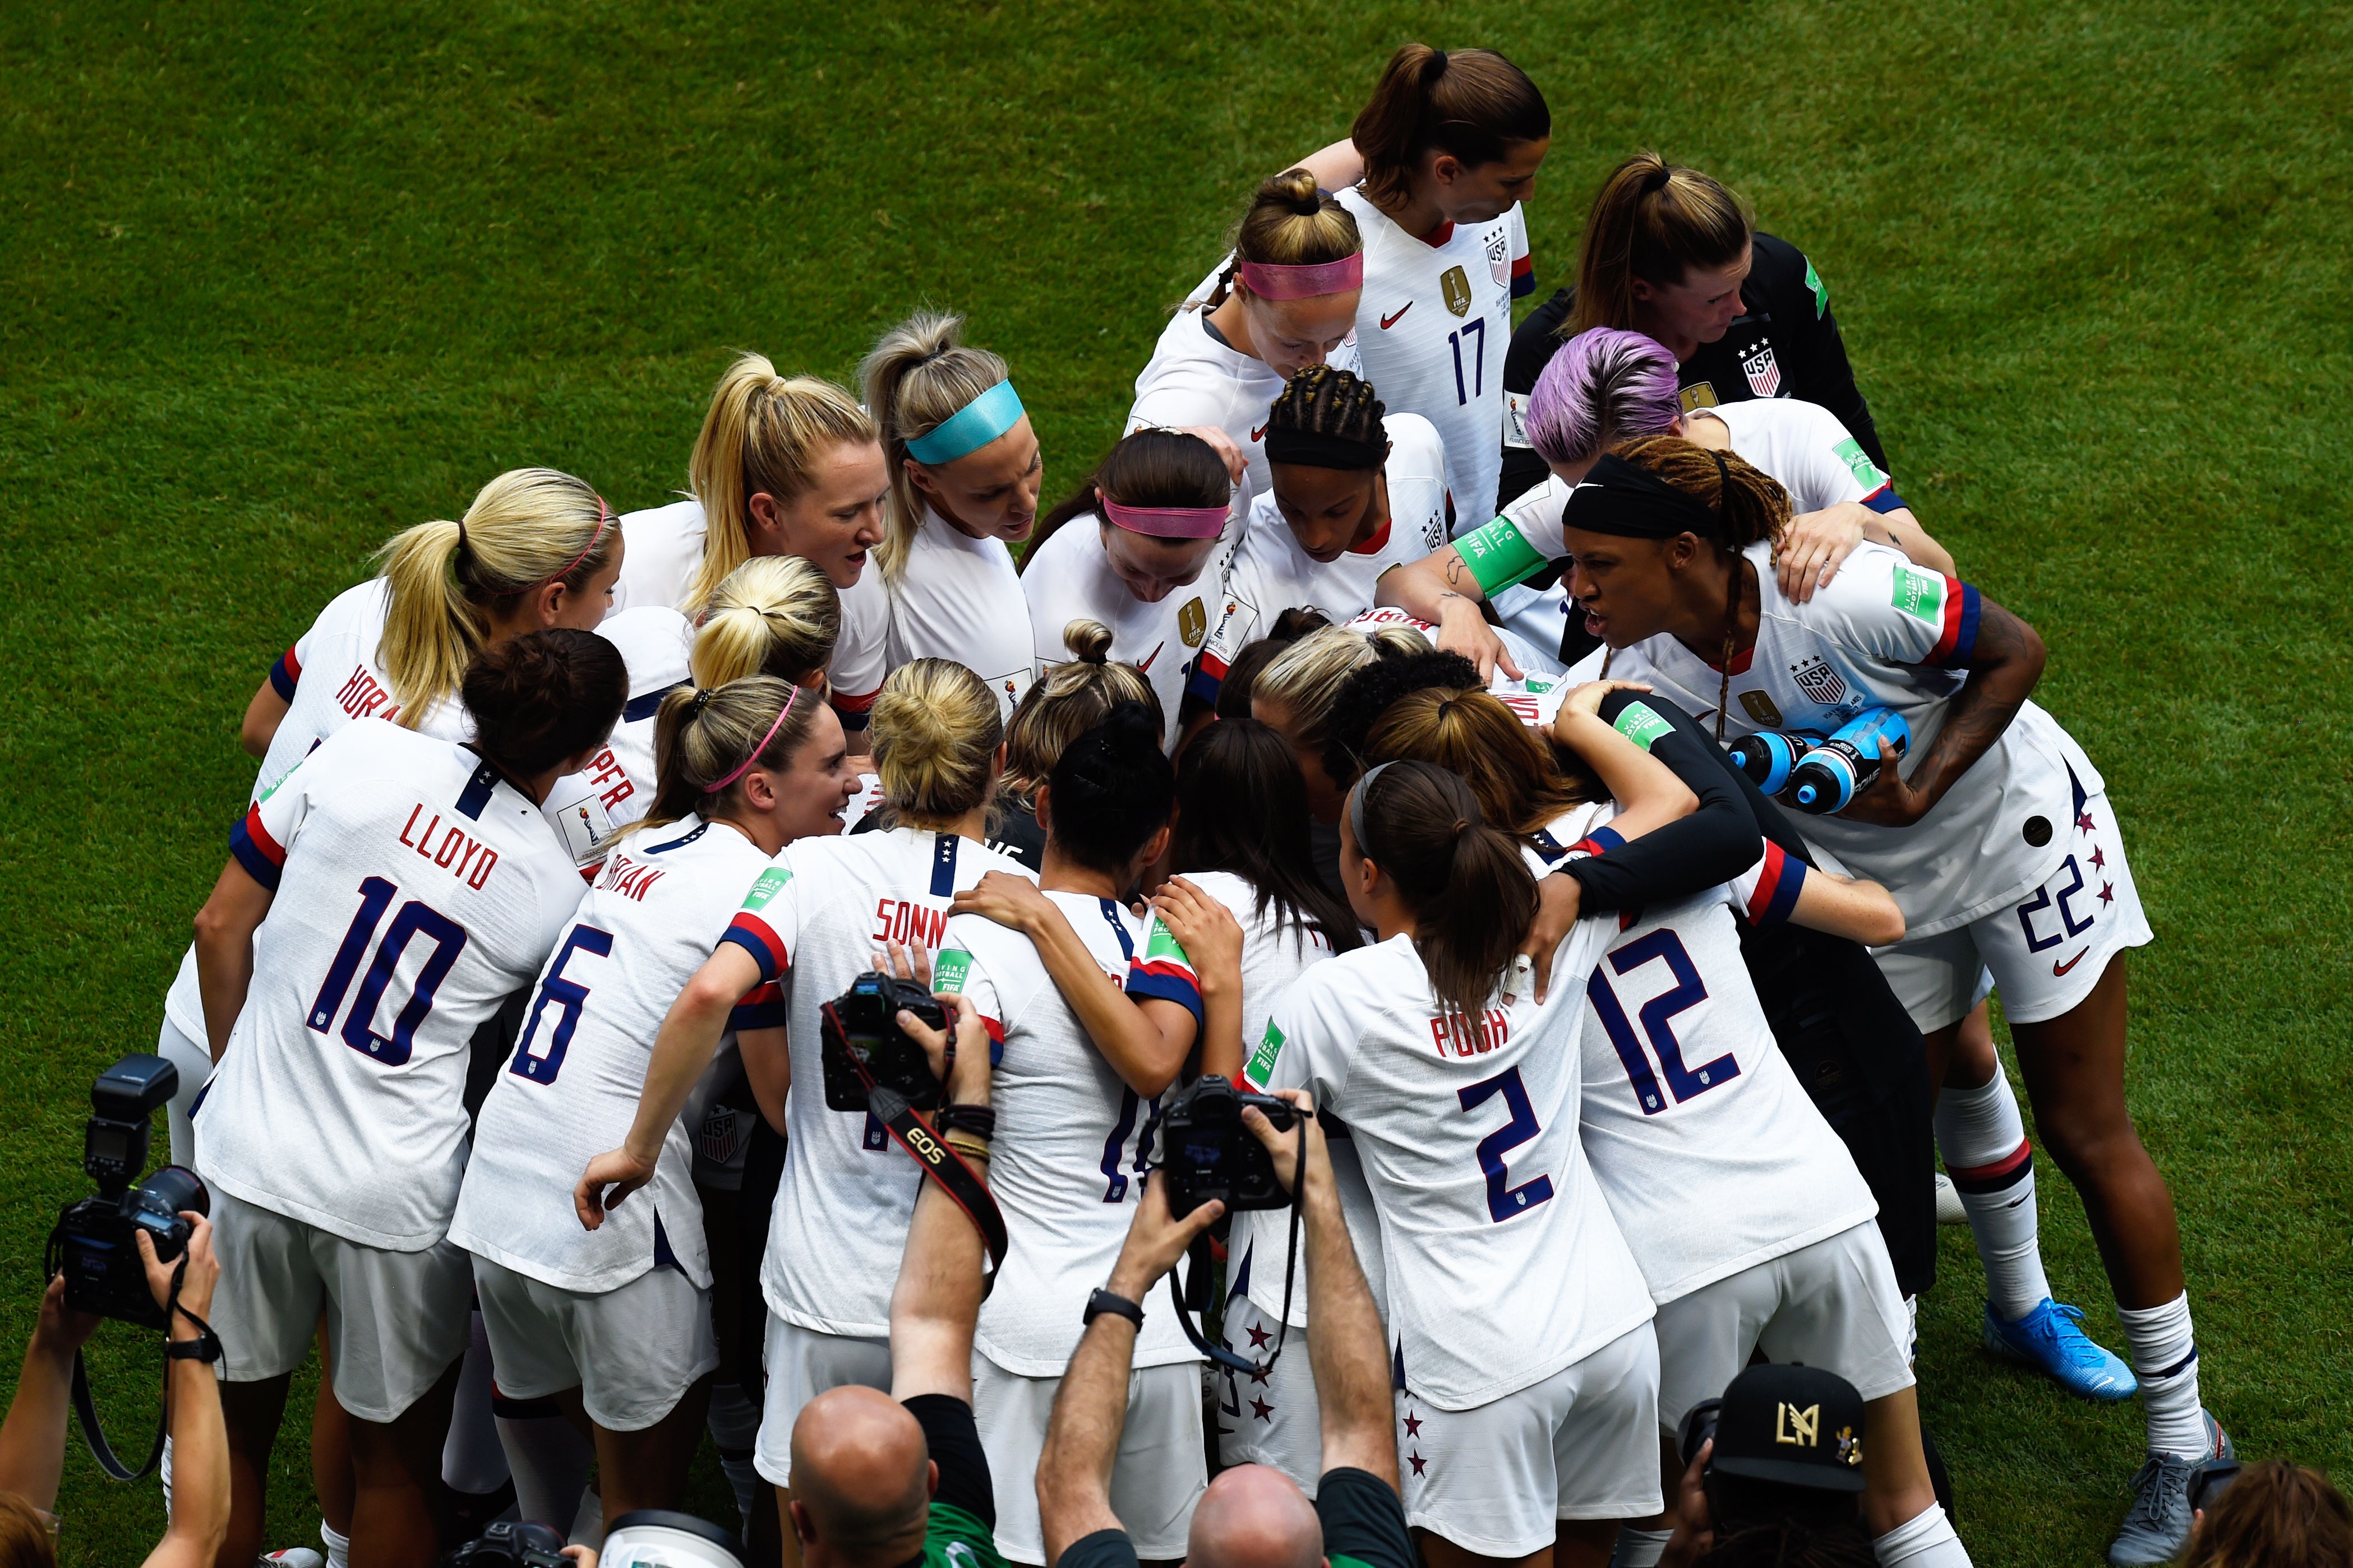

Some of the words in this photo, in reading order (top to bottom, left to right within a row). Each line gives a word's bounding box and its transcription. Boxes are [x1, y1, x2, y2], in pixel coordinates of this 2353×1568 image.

[1489, 240, 1506, 262] USA
[1453, 297, 1466, 308] FIFA
[1448, 317, 1485, 406] 17
[1746, 350, 1773, 374] USA
[1428, 521, 1442, 549] USA
[1464, 534, 1486, 558] FIFA
[1909, 576, 1918, 612] FOOTBALL
[1188, 627, 1201, 639] FIFA
[1799, 665, 1831, 687] USA
[1643, 718, 1661, 729] FIFA
[399, 803, 499, 891] LLOYD
[752, 891, 770, 900] FIFA
[2017, 854, 2095, 954] 22
[873, 899, 949, 950] SONN
[307, 876, 467, 1067] 10
[942, 983, 959, 992] FIFA
[509, 924, 614, 1085] 6
[1586, 927, 1742, 1115] 12
[1256, 1056, 1271, 1072] FIFA
[702, 1117, 733, 1138] USA
[907, 1127, 946, 1164] EOS
[1457, 1065, 1554, 1223] 2
